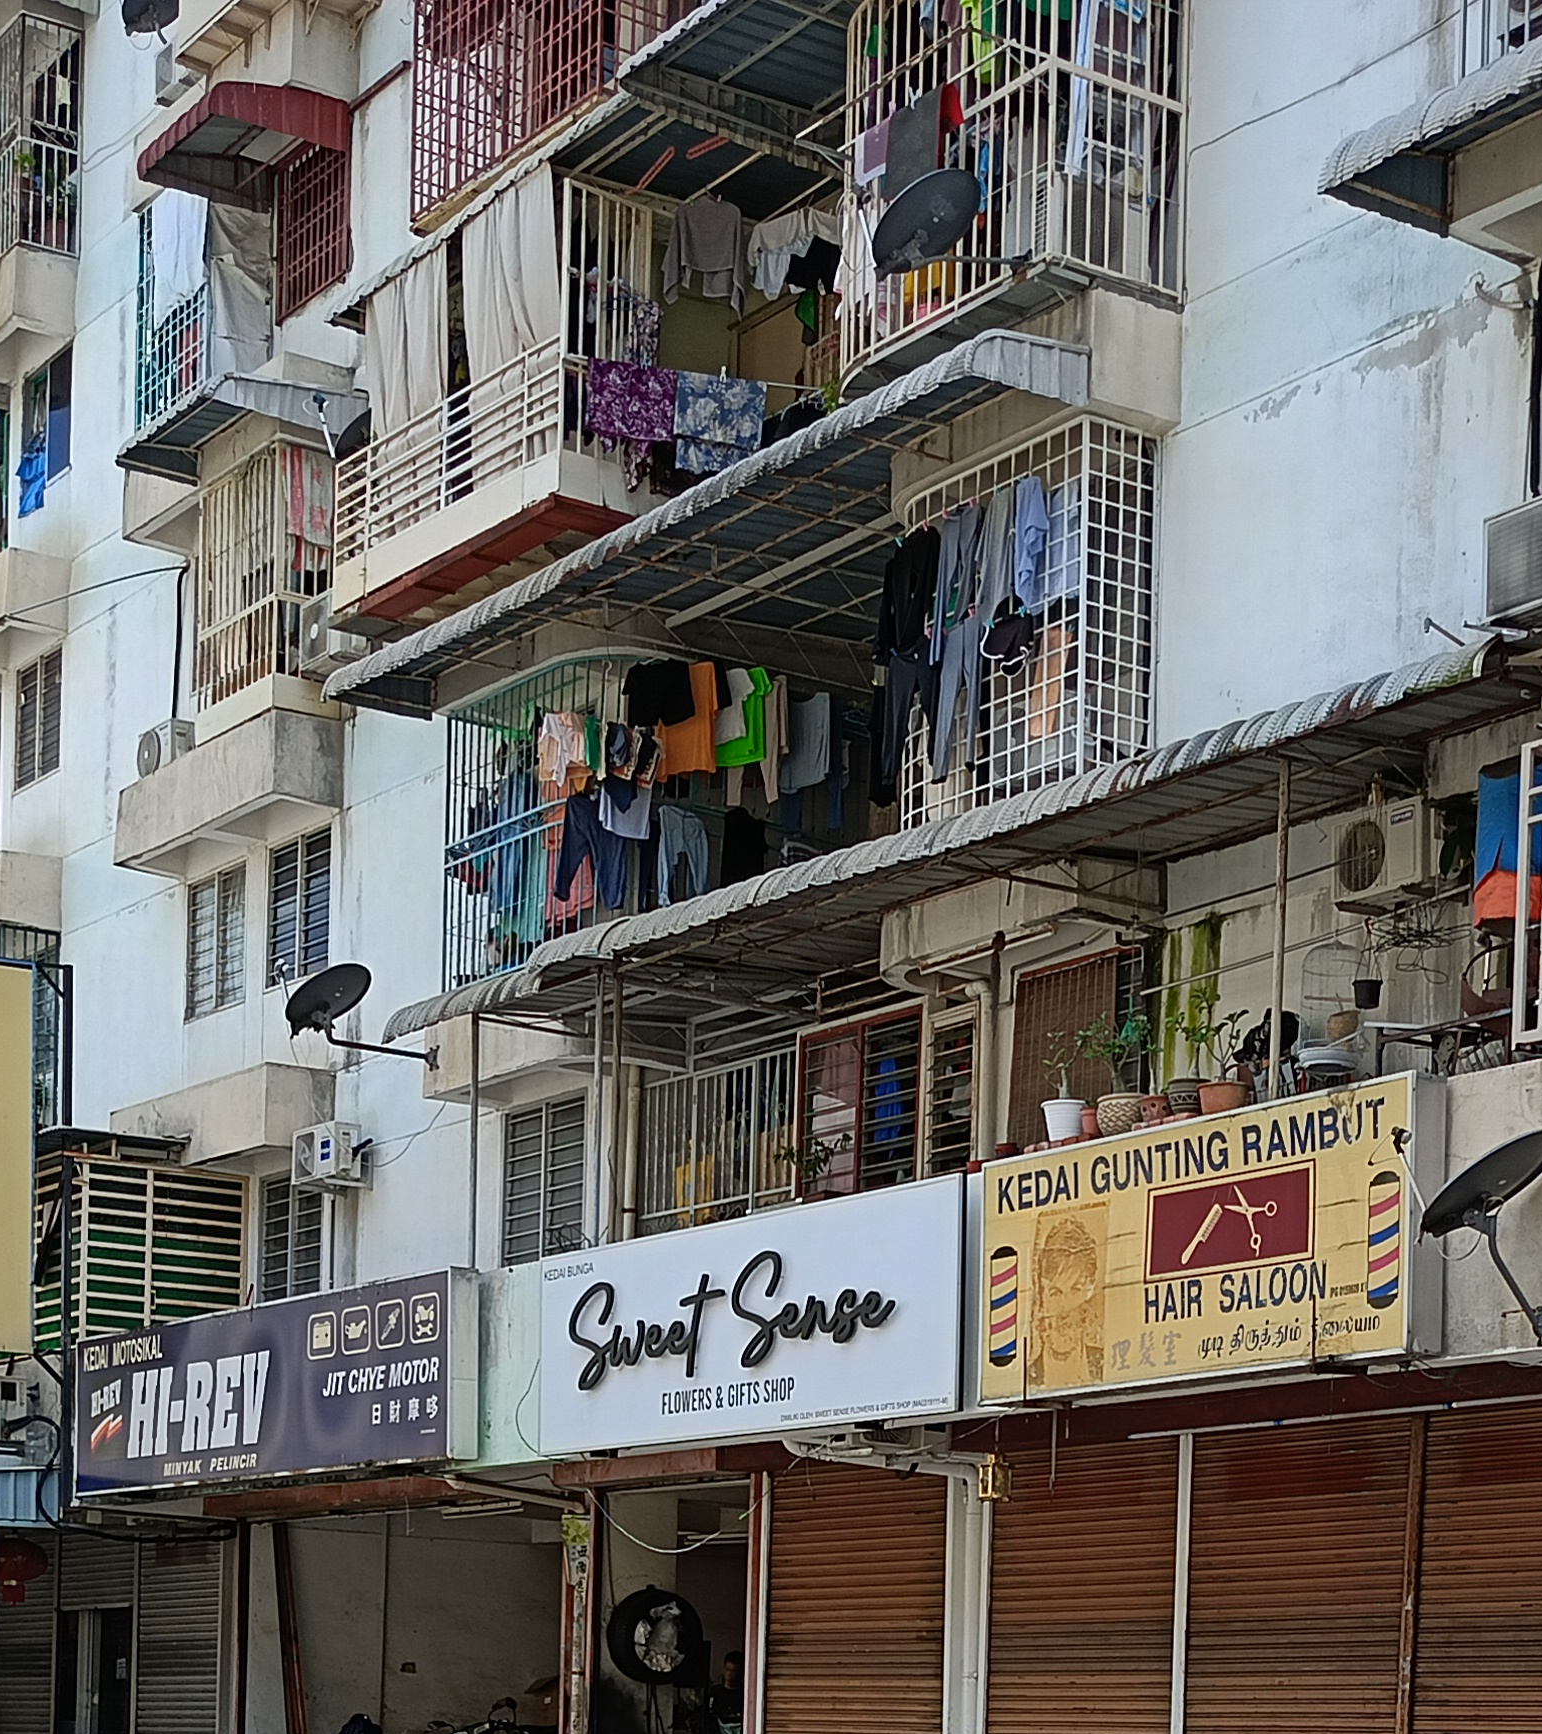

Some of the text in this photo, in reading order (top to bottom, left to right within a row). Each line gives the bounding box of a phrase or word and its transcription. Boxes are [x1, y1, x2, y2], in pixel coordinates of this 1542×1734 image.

[998, 1097, 1385, 1214] KEDAI GUNTING RAMBUT
[543, 1261, 594, 1283] KEDAI BUNGA
[1144, 1258, 1327, 1324] HAIR SALOON
[568, 1250, 897, 1392] Sweet Sense
[83, 1334, 163, 1372] KEDAI MOTOSIKAL
[322, 1357, 439, 1397] JIT CHYE MOTOR
[661, 1376, 795, 1416] FLOWERS & GIFTS SHOP
[91, 1379, 122, 1418] HI-REV
[127, 1350, 270, 1459] HI-REV
[164, 1454, 257, 1477] MINYAK PELINCIR
